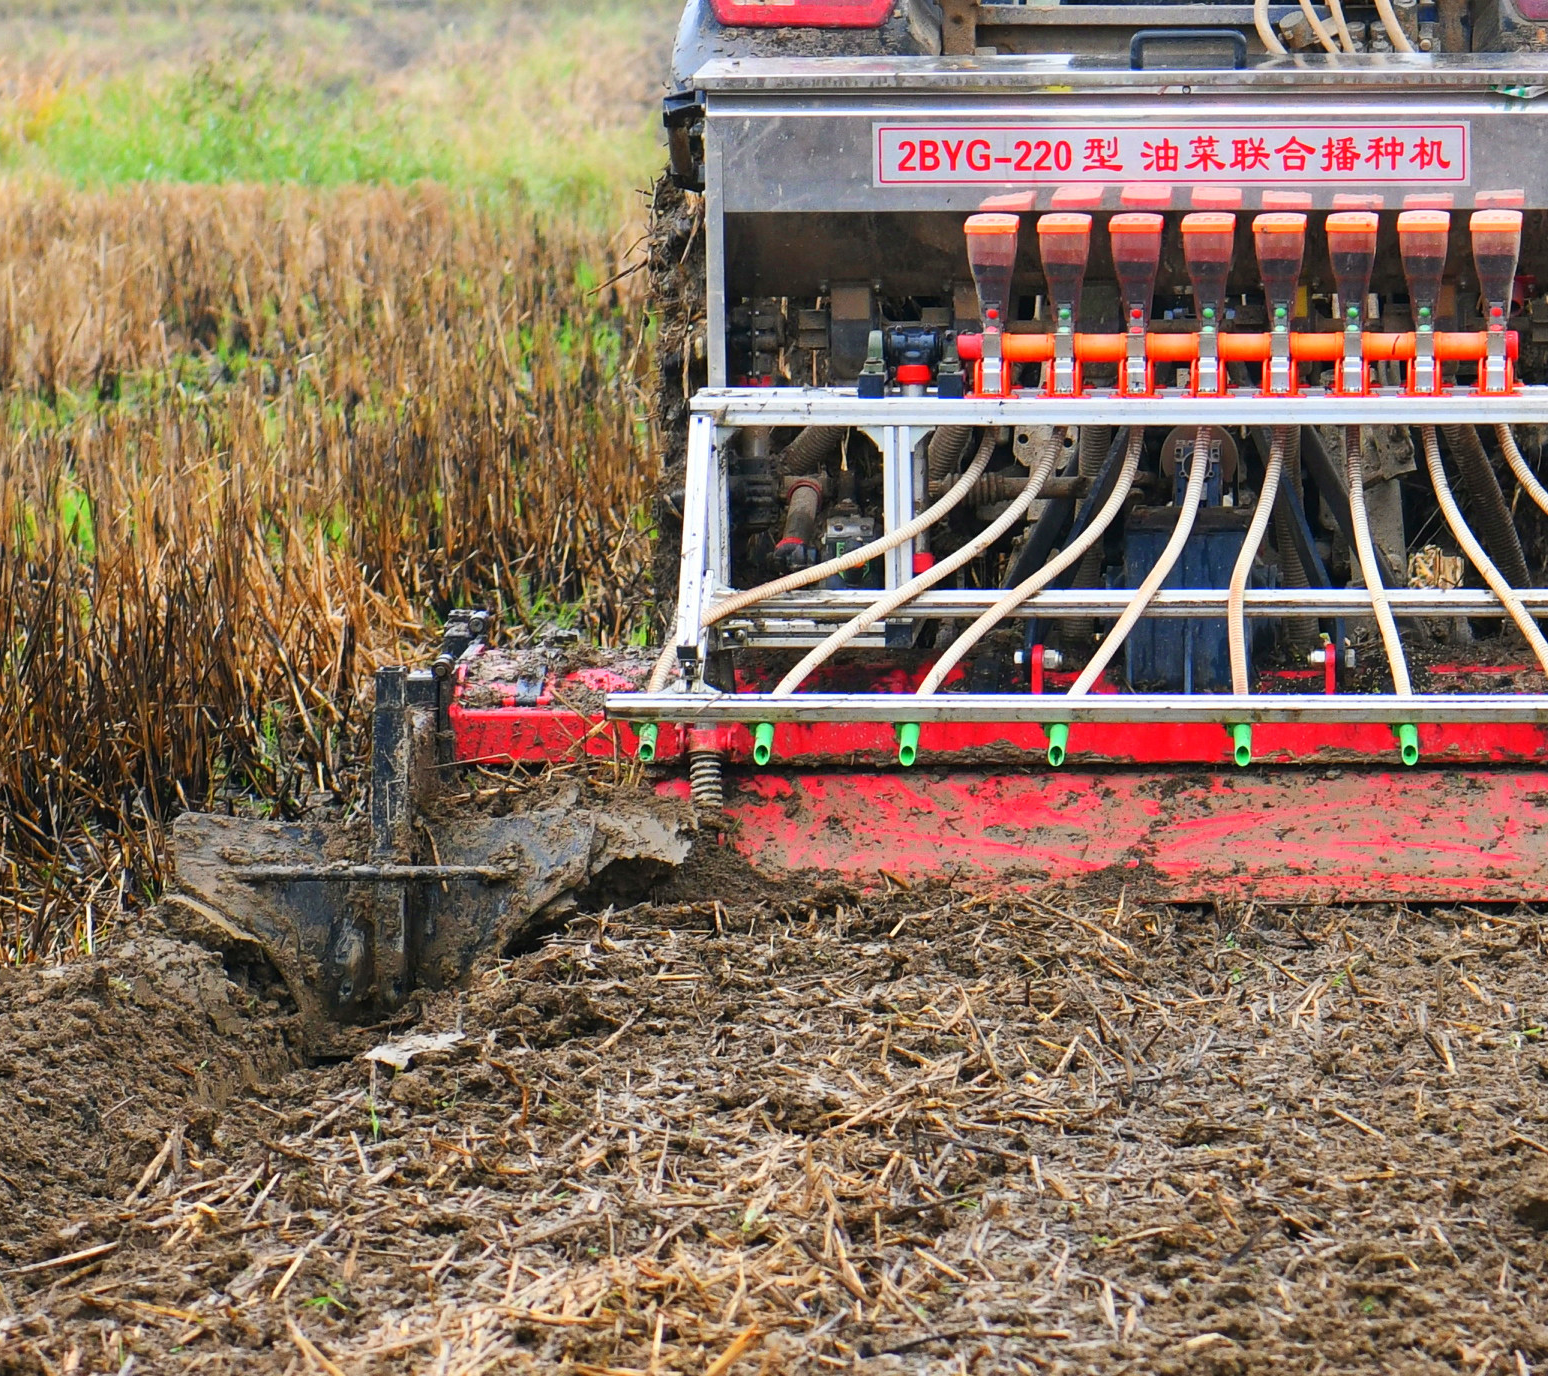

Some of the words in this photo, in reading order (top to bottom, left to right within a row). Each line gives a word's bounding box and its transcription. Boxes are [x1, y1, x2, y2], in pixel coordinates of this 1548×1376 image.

[1139, 135, 1451, 172] 油菜联合播种机
